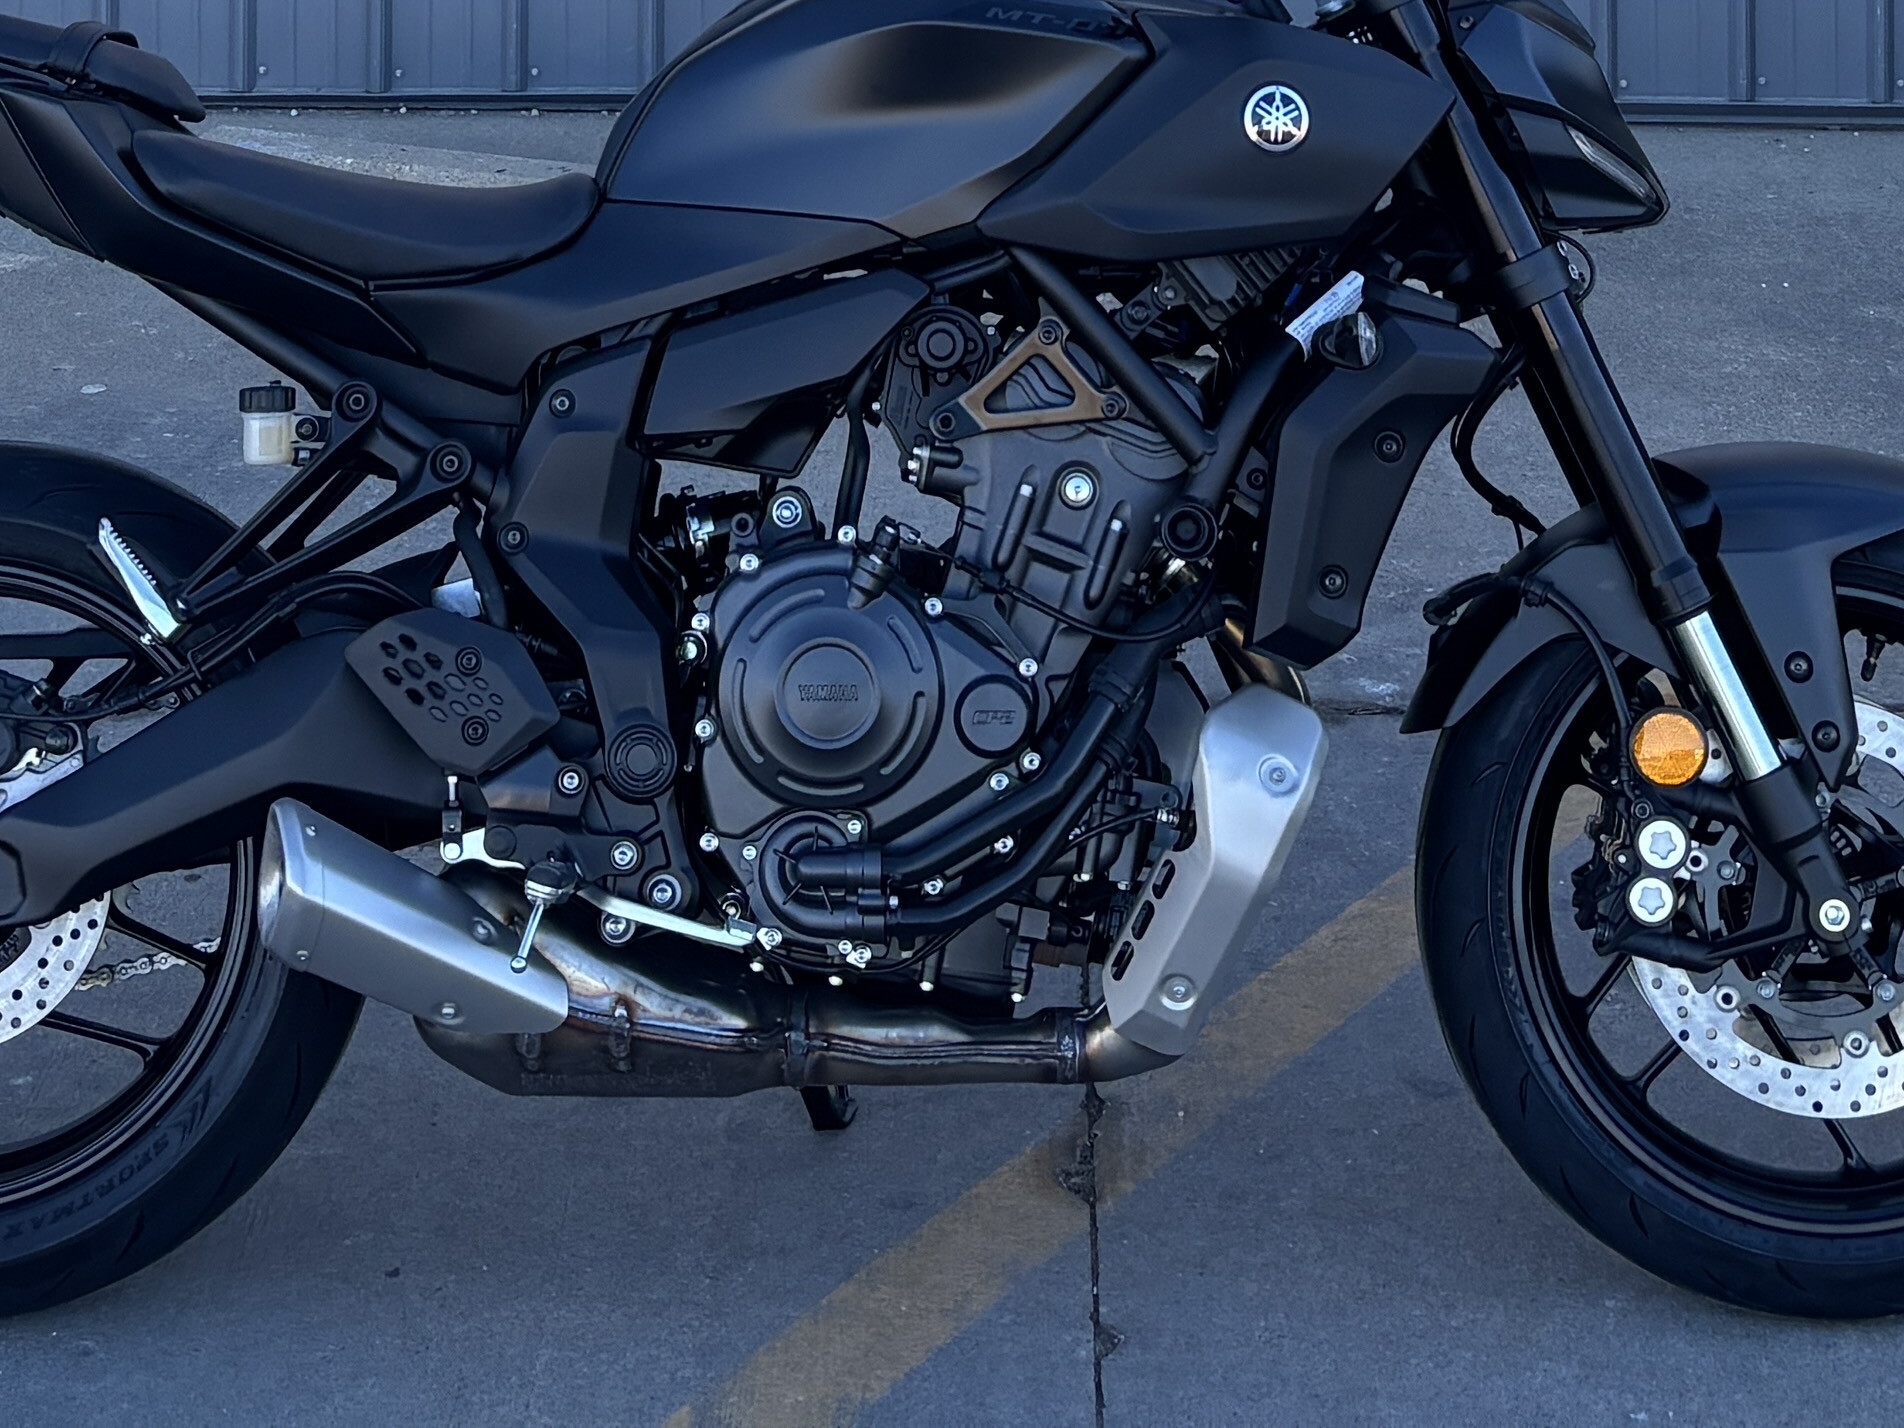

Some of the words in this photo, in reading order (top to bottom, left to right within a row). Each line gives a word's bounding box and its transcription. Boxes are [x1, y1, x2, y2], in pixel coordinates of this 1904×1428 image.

[985, 7, 1122, 34] MT-0
[798, 683, 859, 702] YAMAHA
[6, 1134, 170, 1240] SPORTMAX
